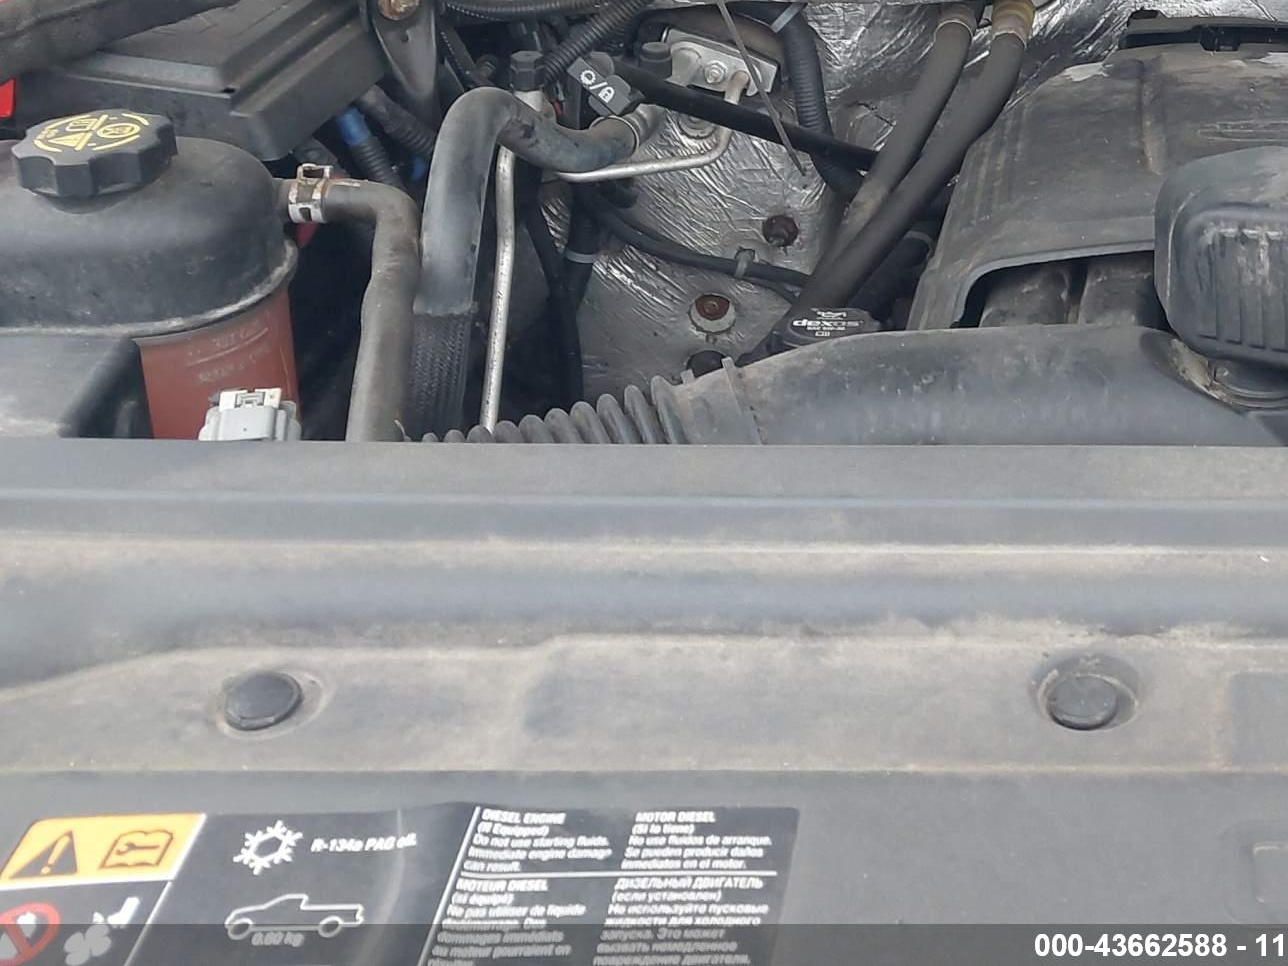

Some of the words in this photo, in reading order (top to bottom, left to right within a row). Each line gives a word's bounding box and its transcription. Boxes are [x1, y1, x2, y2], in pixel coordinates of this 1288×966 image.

[481, 808, 521, 824] DIESEL
[522, 812, 567, 825] ENGINE
[635, 811, 677, 823] MOTOR
[677, 811, 716, 823] DIESEL
[662, 823, 695, 835] tiene)
[310, 838, 364, 852] R-134a
[364, 836, 397, 851] PAG
[472, 833, 489, 846] Do
[489, 835, 510, 848] not
[510, 838, 532, 848] use
[532, 836, 576, 849] starting
[705, 834, 721, 846] de
[528, 849, 566, 861] engine
[682, 846, 730, 859] producir
[455, 878, 507, 892] MOTEUR
[507, 878, 548, 892] DIESEL
[692, 876, 763, 890] ДВИГАТЕЛЬ
